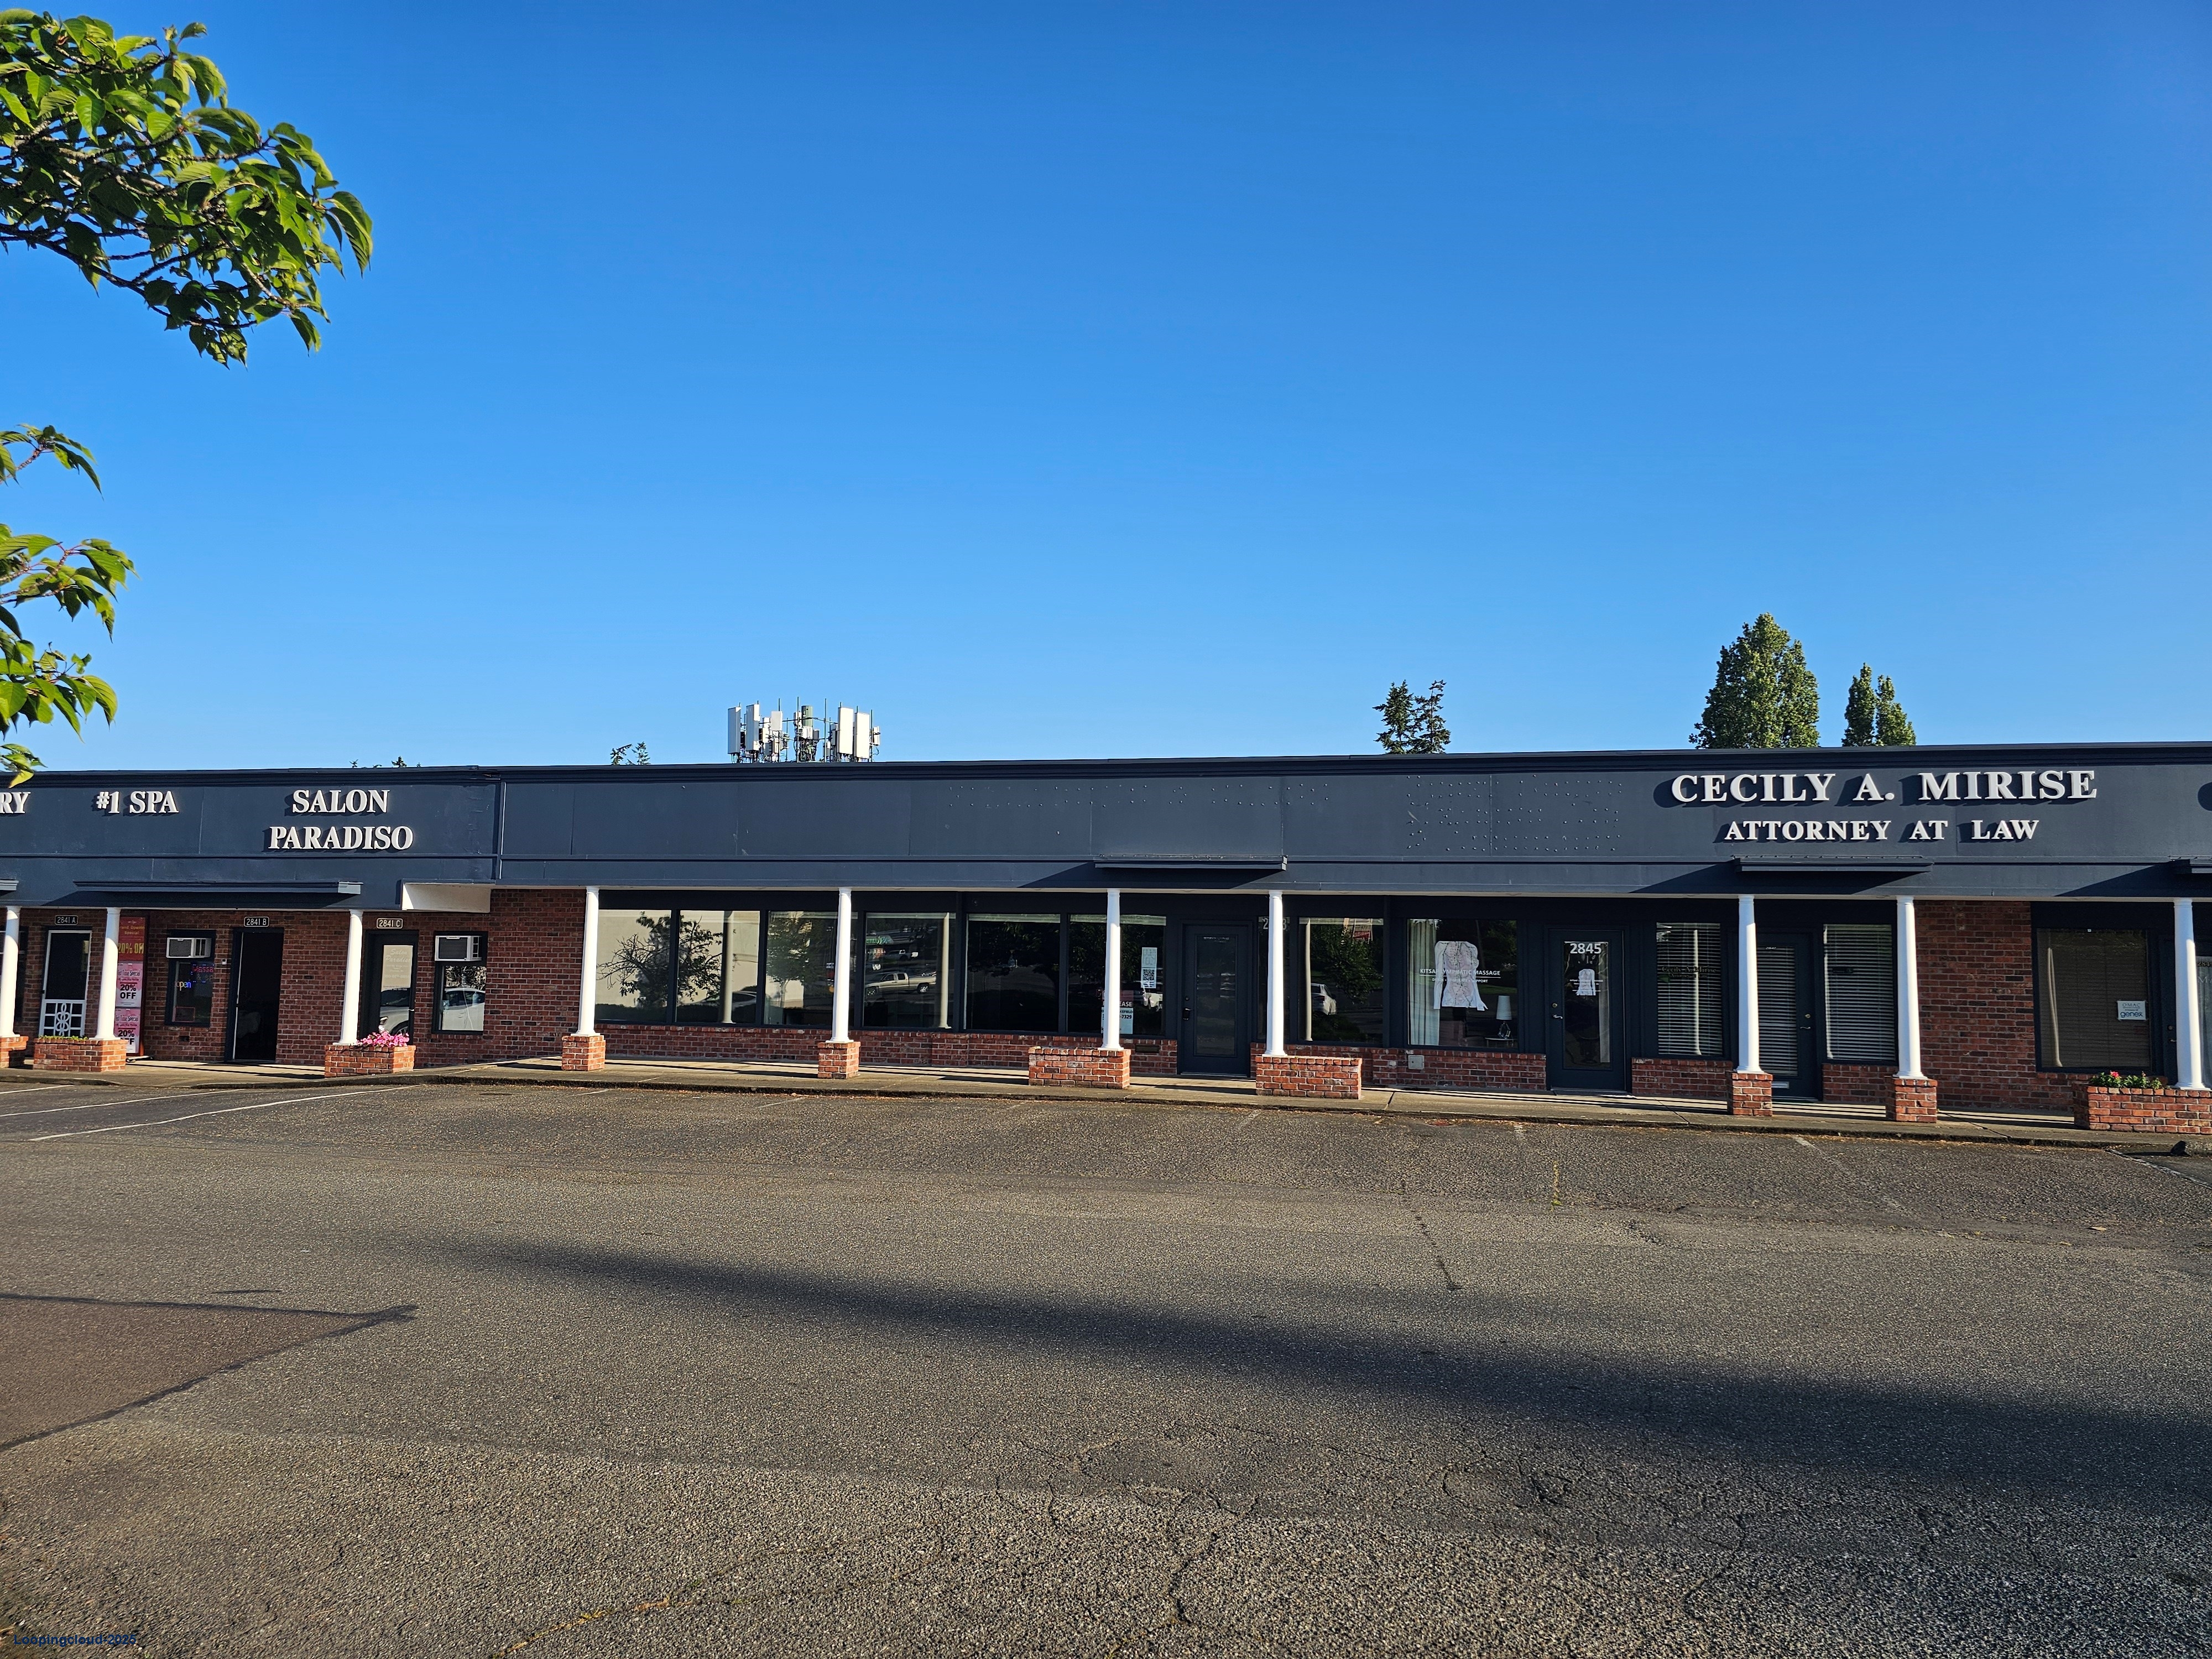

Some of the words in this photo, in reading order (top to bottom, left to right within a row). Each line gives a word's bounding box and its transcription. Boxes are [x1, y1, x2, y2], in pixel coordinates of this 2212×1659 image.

[1671, 773, 1835, 804] CECILY
[1852, 774, 1895, 801] A.
[1918, 769, 2097, 801] MIRISE
[96, 791, 120, 814] #1
[129, 790, 179, 813] SPA
[292, 789, 390, 813] SALON
[268, 826, 414, 850] PARADISO
[1724, 820, 1891, 841] ATTORNEY
[1911, 820, 1948, 841] AT
[1971, 819, 2039, 841] LAW
[1569, 942, 1601, 954] 2845
[176, 981, 191, 991] open
